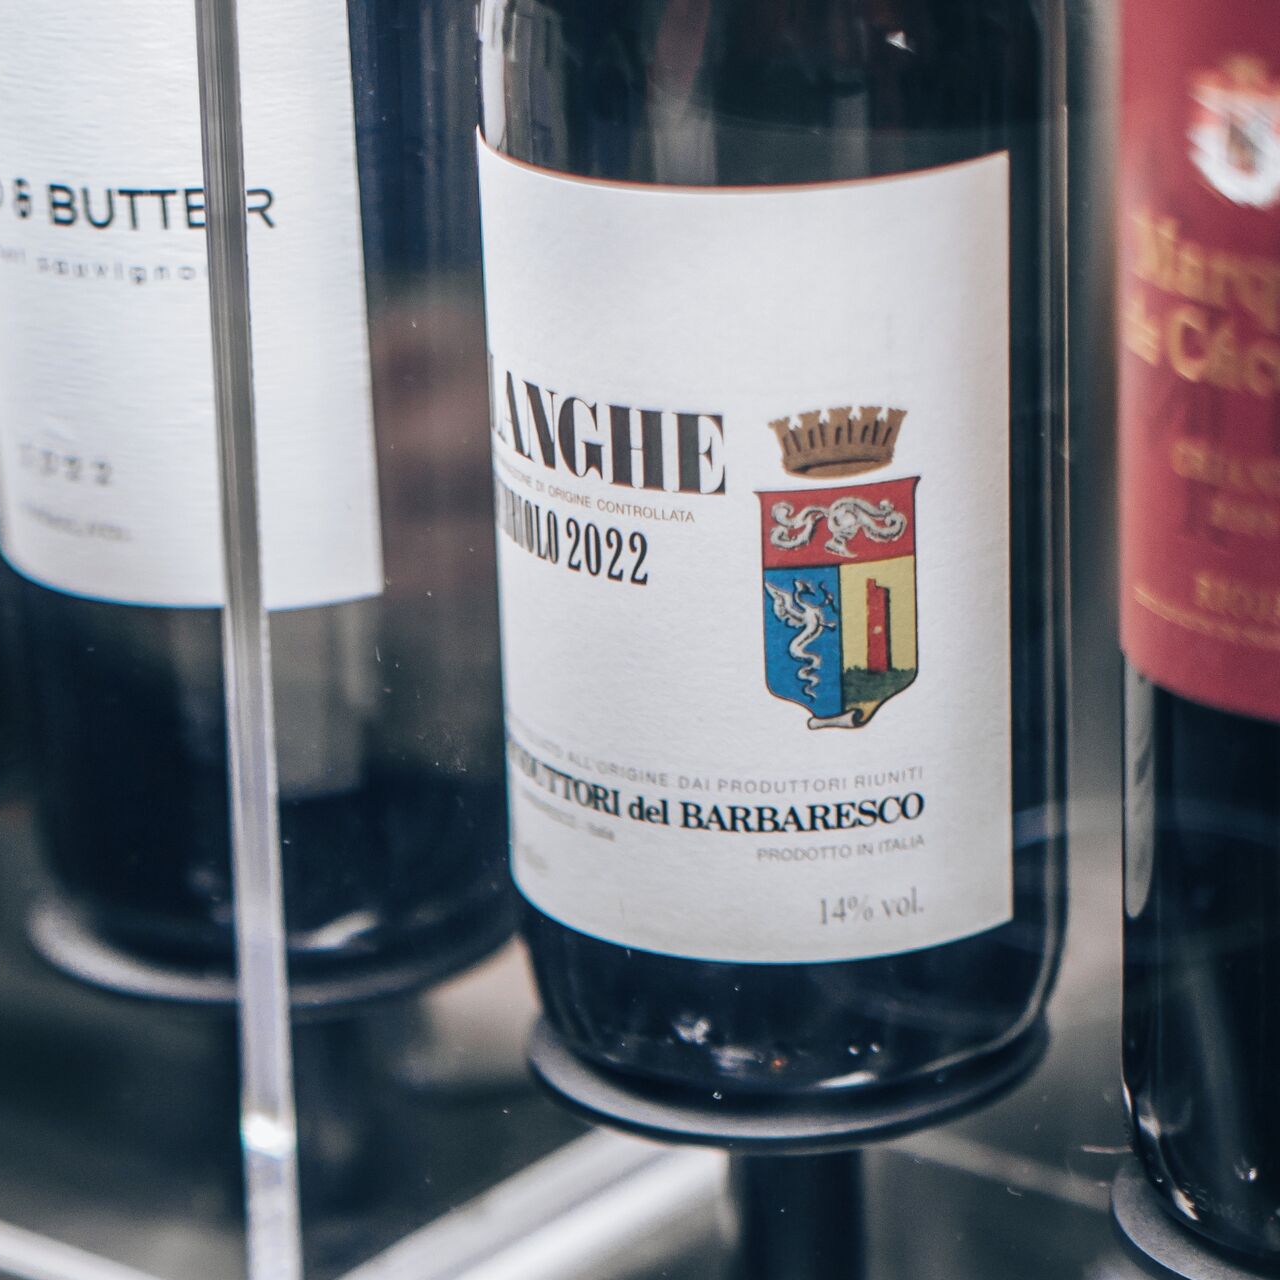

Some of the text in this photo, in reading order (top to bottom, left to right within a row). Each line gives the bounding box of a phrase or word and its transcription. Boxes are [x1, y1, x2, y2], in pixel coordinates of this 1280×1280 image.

[48, 183, 276, 231] BUTTER
[548, 485, 592, 508] ORIGINE
[596, 499, 696, 523] CONTROLLATA
[566, 516, 648, 585] 2022
[677, 775, 710, 791] DAI
[717, 777, 847, 794] PRODUTTORI
[854, 765, 923, 788] RIUNITI
[628, 795, 670, 825] del
[679, 792, 925, 833] BARBARESCO
[757, 833, 926, 862] PRODOTTO IN ITALIA
[819, 885, 925, 926] 14% vol.
